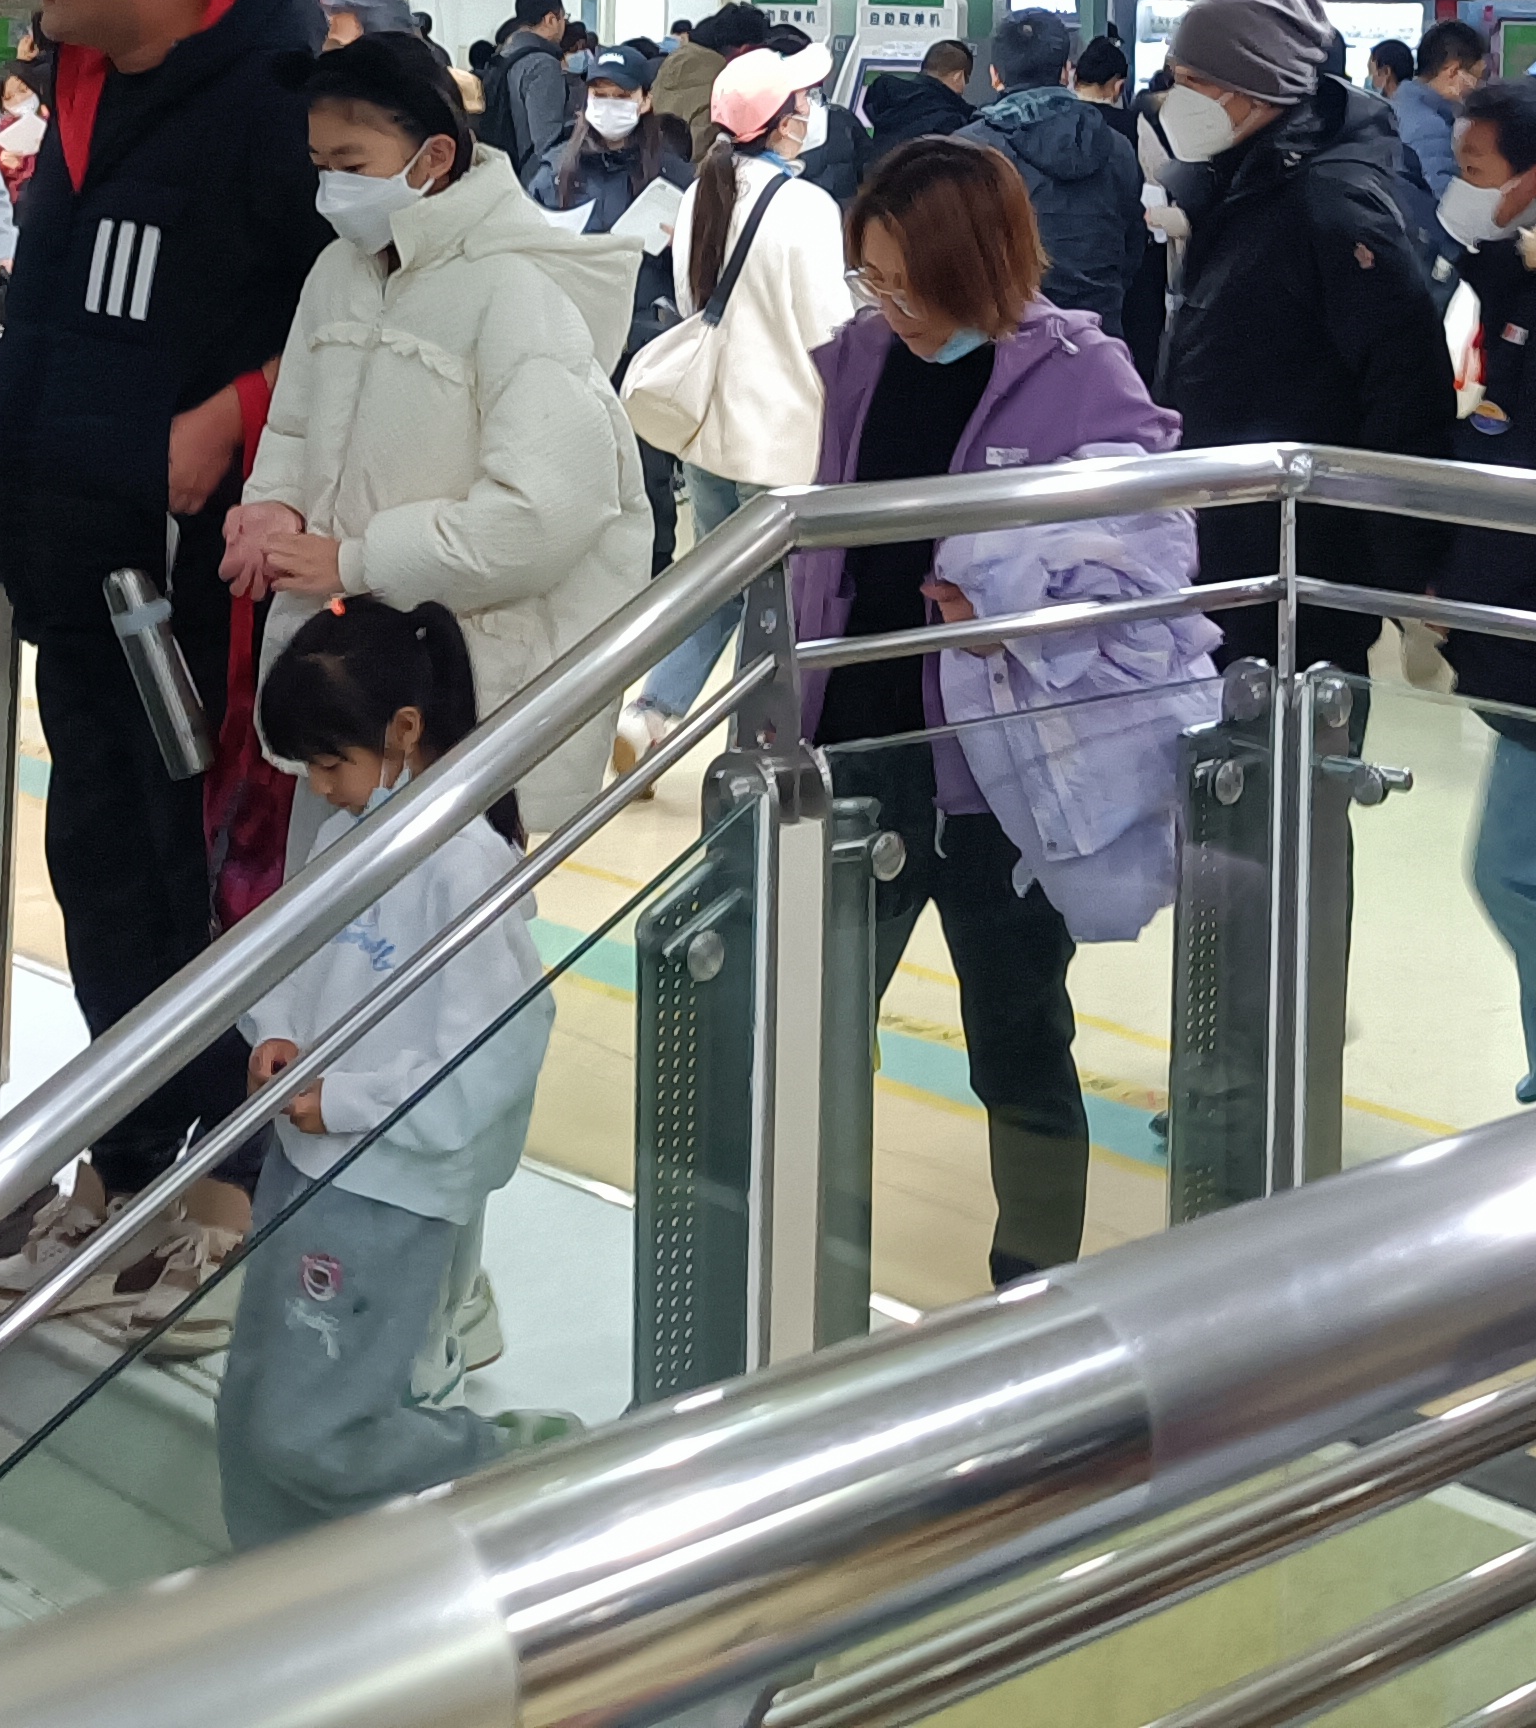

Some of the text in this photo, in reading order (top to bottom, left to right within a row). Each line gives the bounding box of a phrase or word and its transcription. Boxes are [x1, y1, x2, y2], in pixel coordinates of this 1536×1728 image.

[764, 8, 816, 24] 助取单机
[869, 11, 941, 27] 自助取单机
